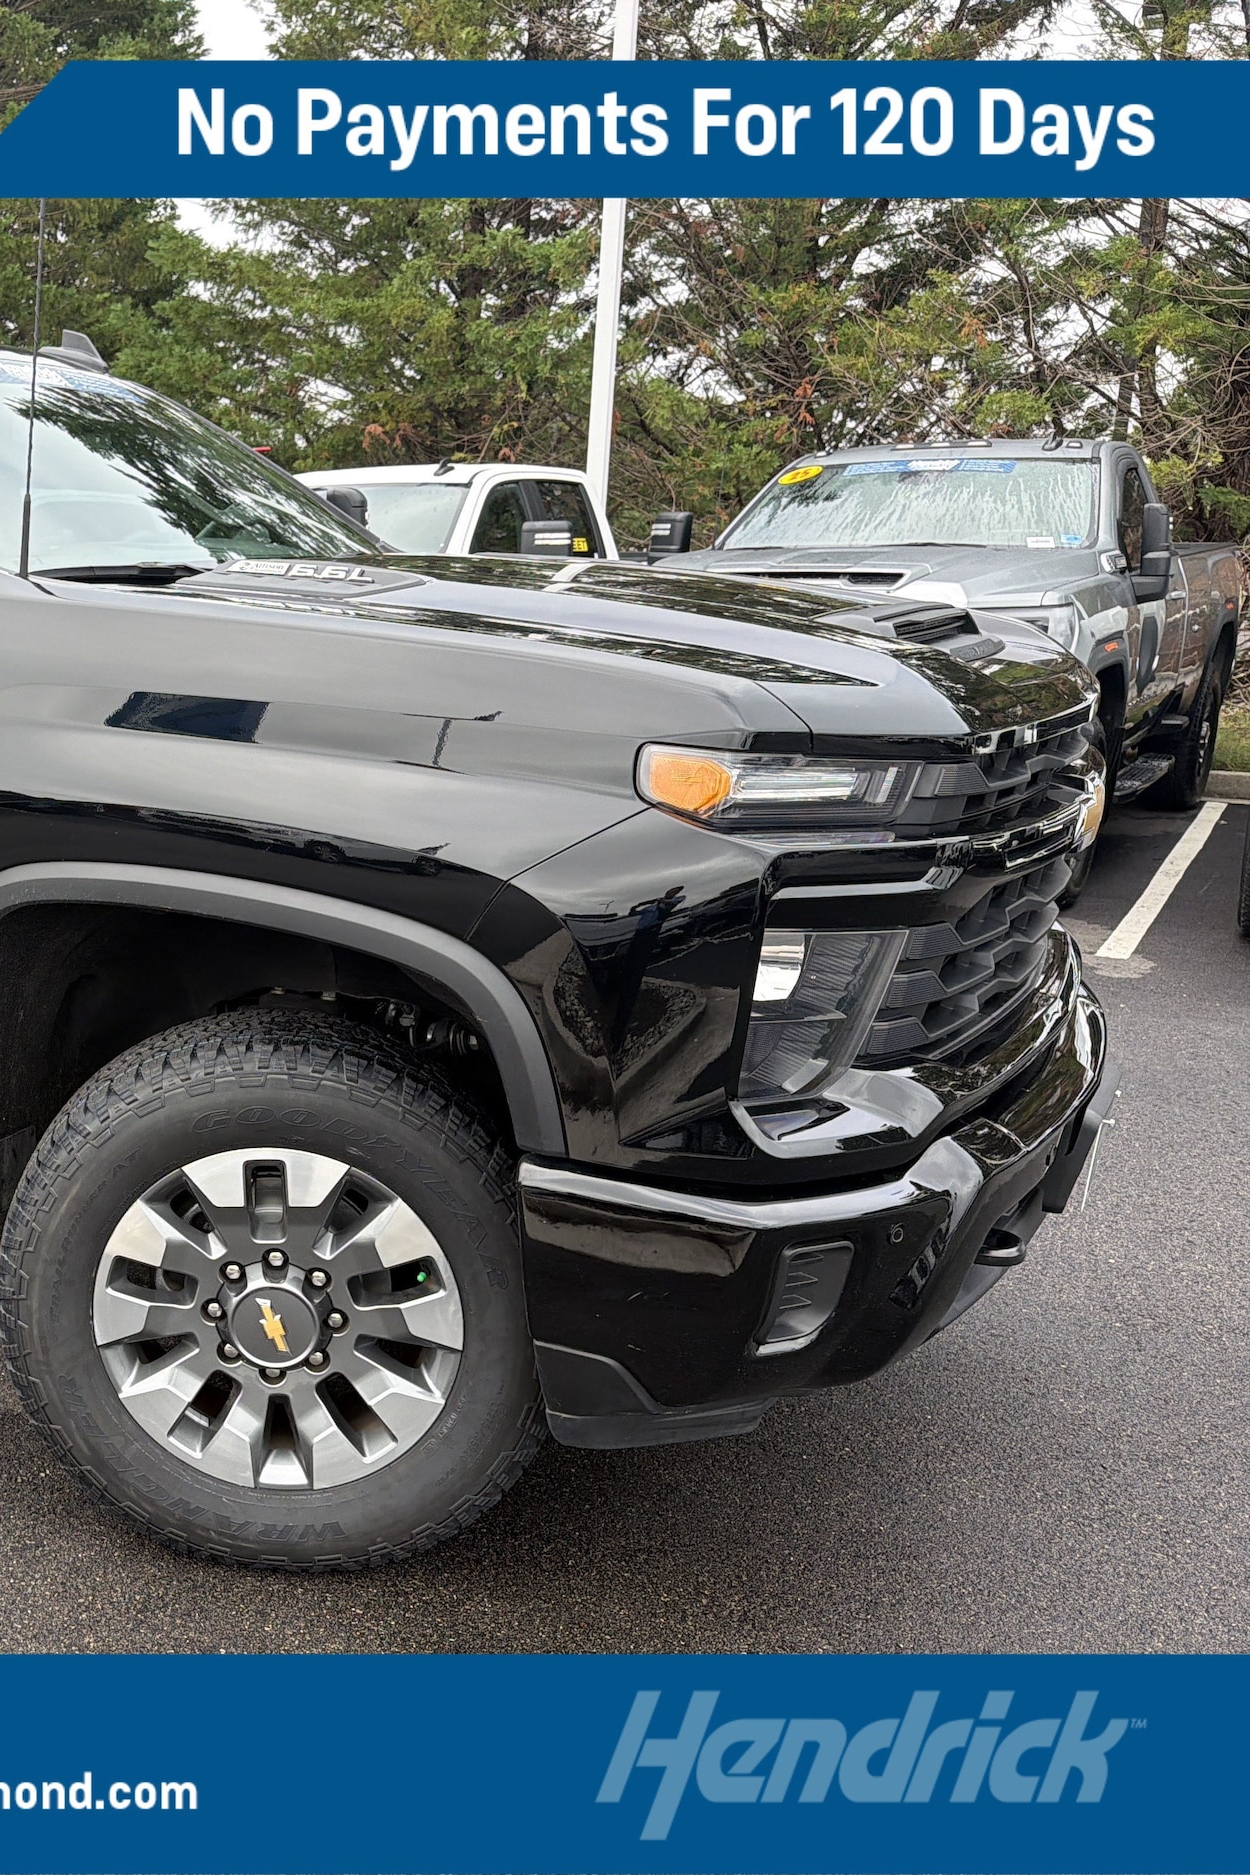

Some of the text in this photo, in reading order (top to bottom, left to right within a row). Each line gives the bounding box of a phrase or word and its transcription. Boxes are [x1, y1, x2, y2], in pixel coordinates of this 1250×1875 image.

[289, 563, 375, 583] 6.6L
[192, 1106, 510, 1291] GOODYEAR
[59, 1374, 349, 1543] WRANGLER
